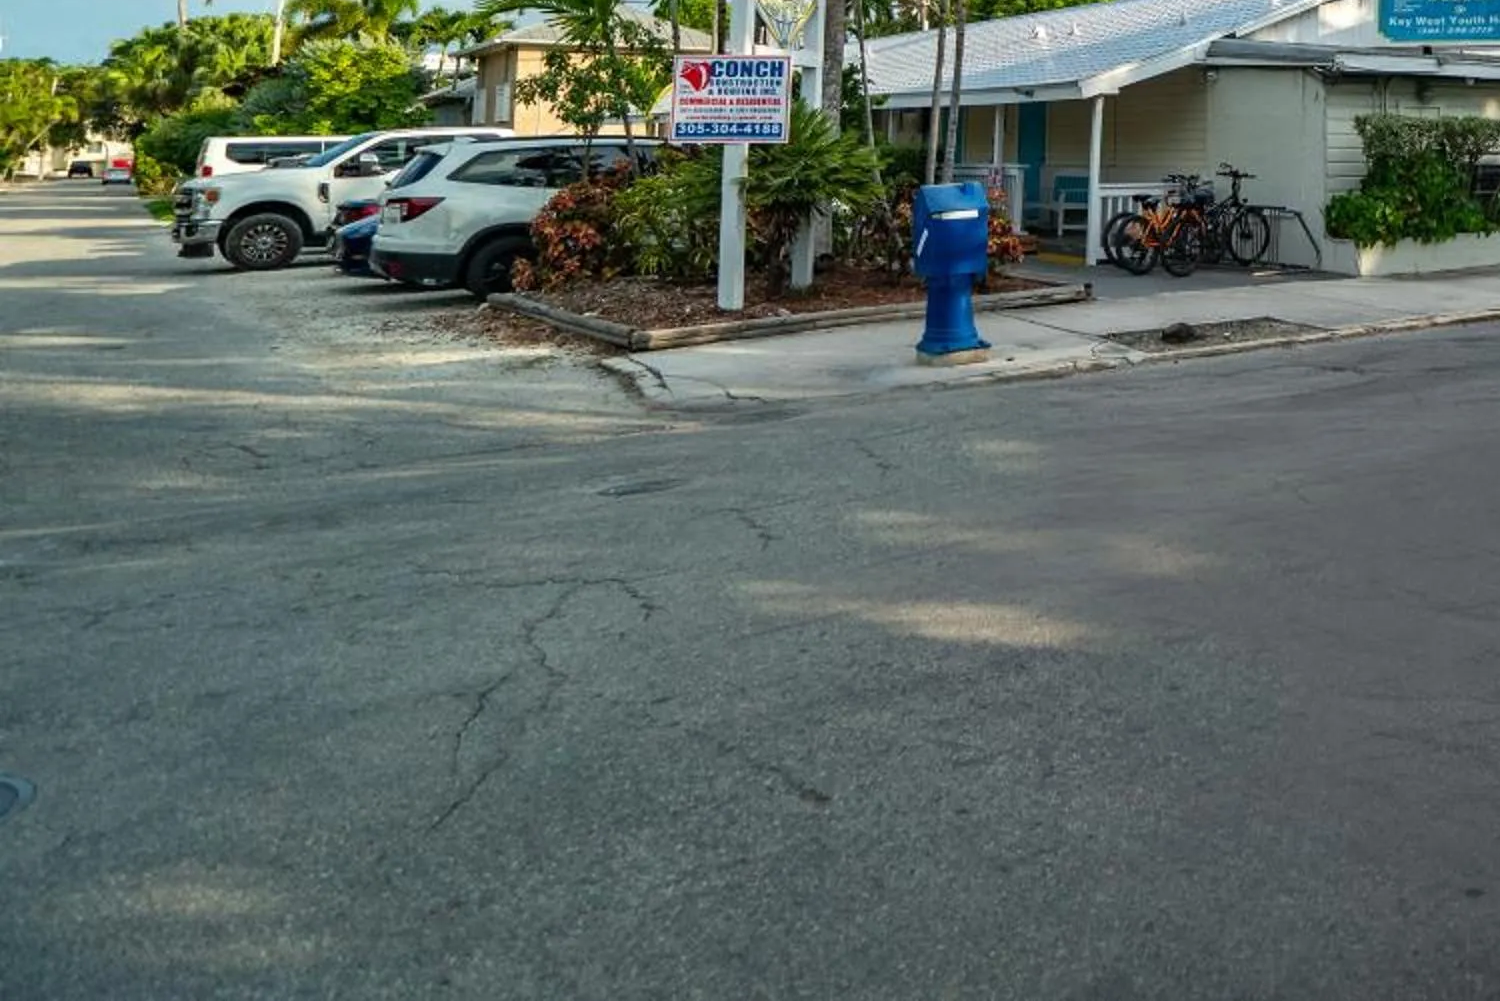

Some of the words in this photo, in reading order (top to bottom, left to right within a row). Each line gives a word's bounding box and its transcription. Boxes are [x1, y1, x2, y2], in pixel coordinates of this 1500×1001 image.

[1388, 16, 1411, 27] Key
[1415, 16, 1445, 27] West
[1450, 15, 1486, 26] Youth
[710, 60, 784, 78] CONCH
[677, 123, 781, 135] 305-304-4188
